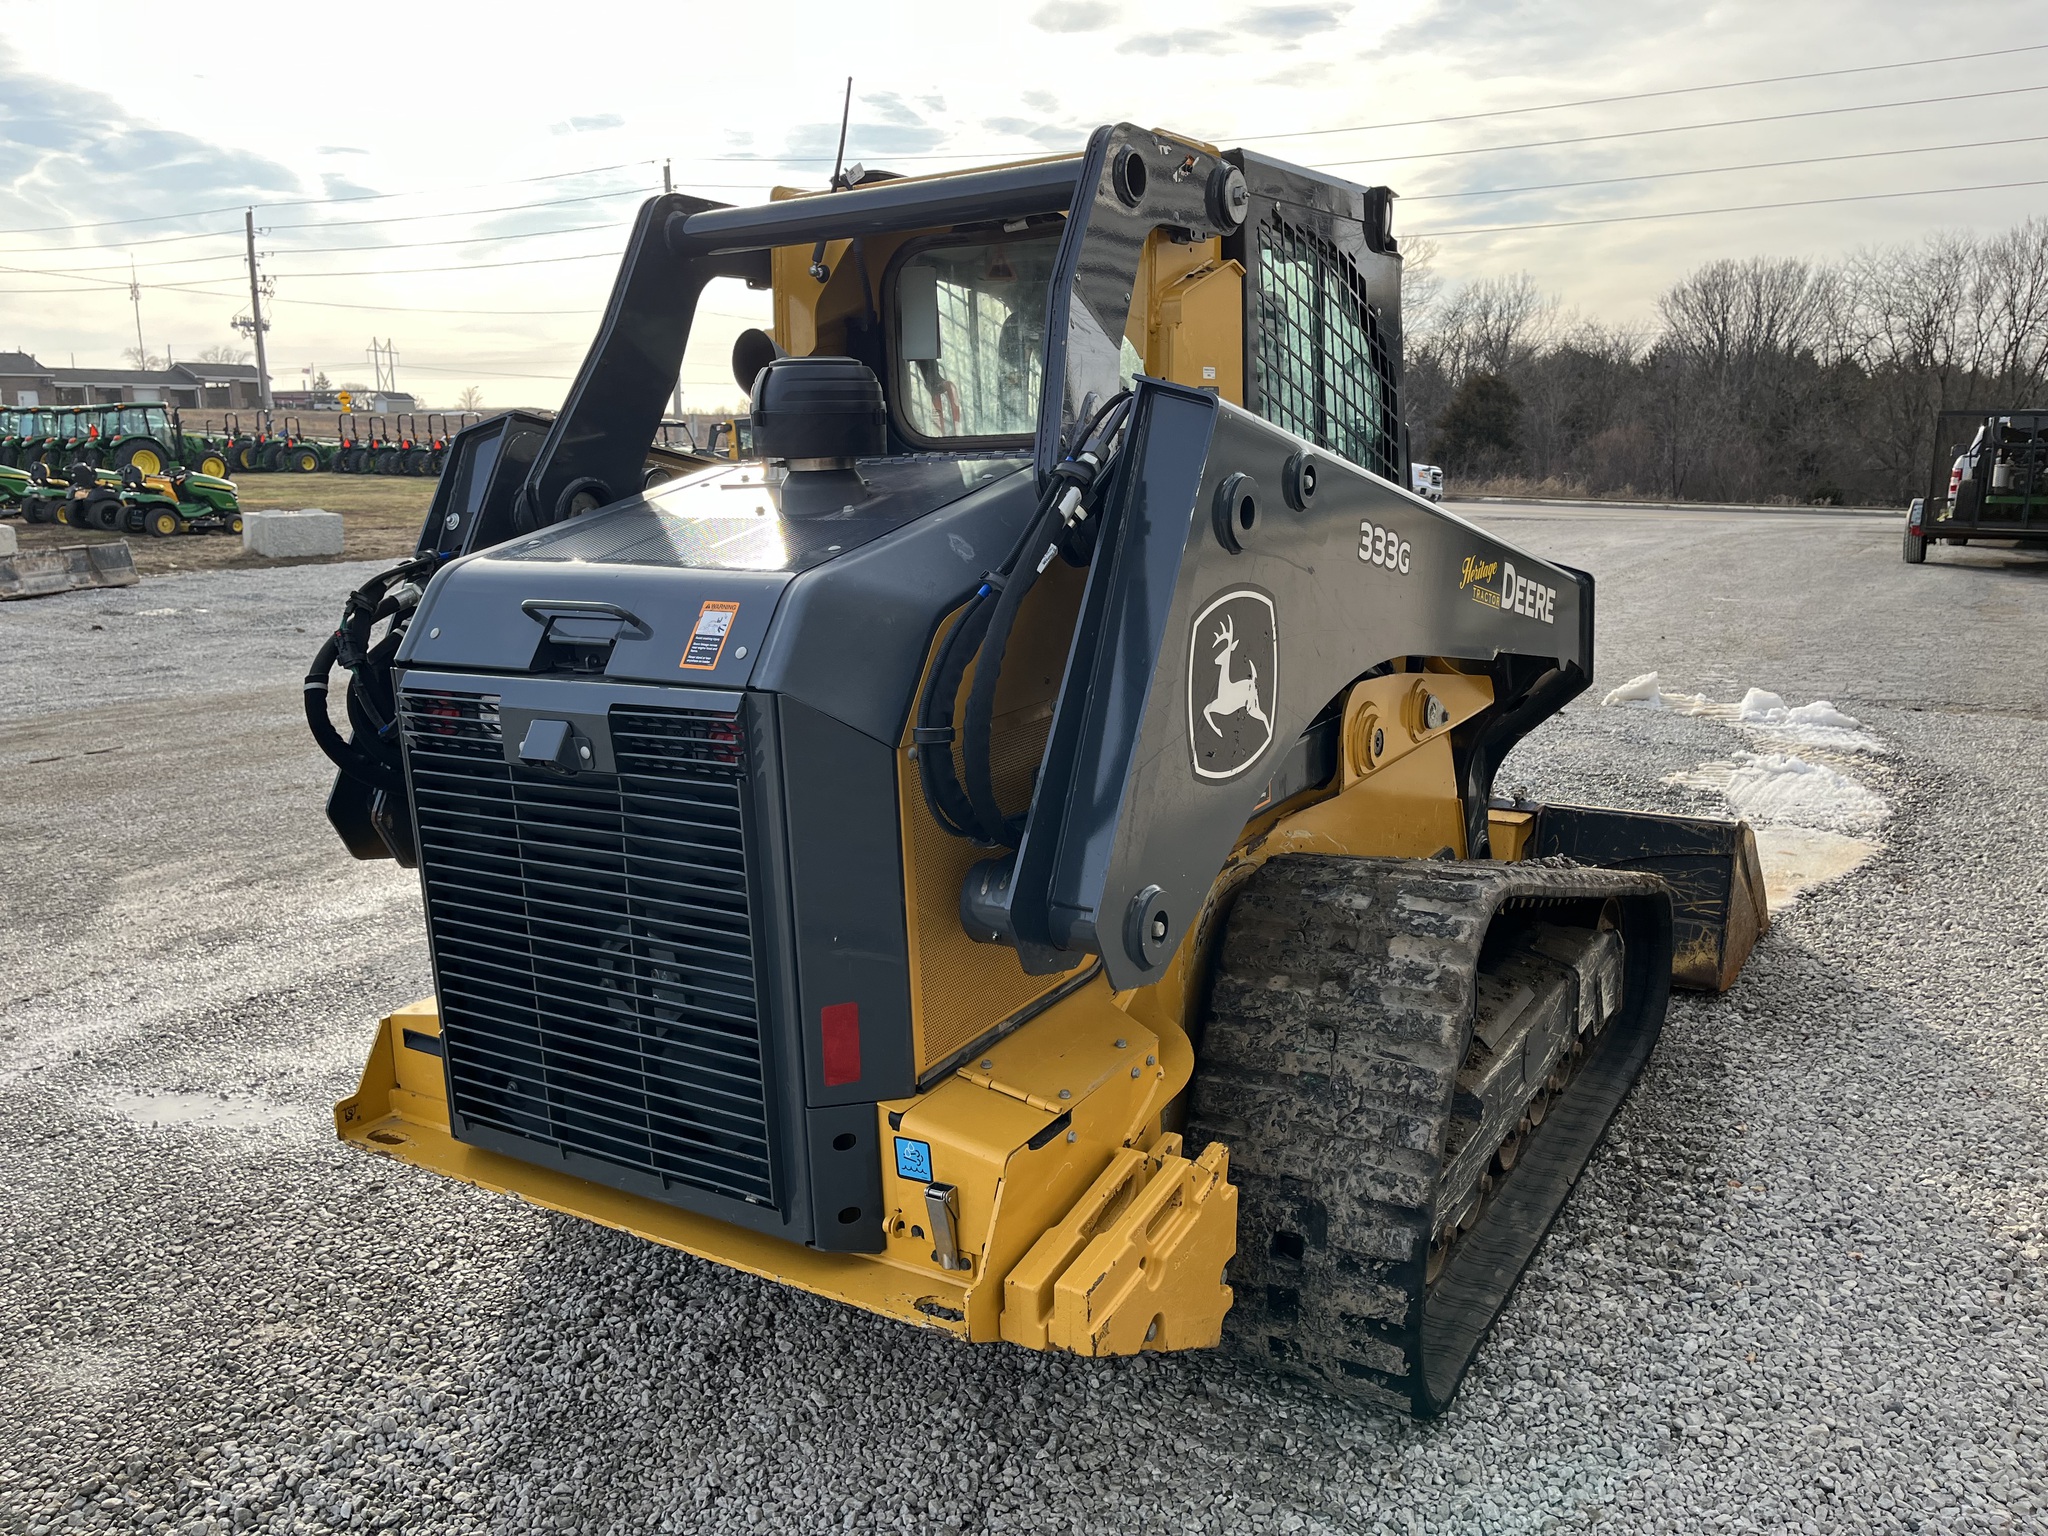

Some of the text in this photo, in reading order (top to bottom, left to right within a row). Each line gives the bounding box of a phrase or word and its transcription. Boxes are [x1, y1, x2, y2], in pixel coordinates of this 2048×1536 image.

[1358, 521, 1411, 575] 333G
[1459, 554, 1498, 590] Heritage
[1501, 561, 1557, 624] DEERE
[1472, 587, 1500, 607] TRACTOR
